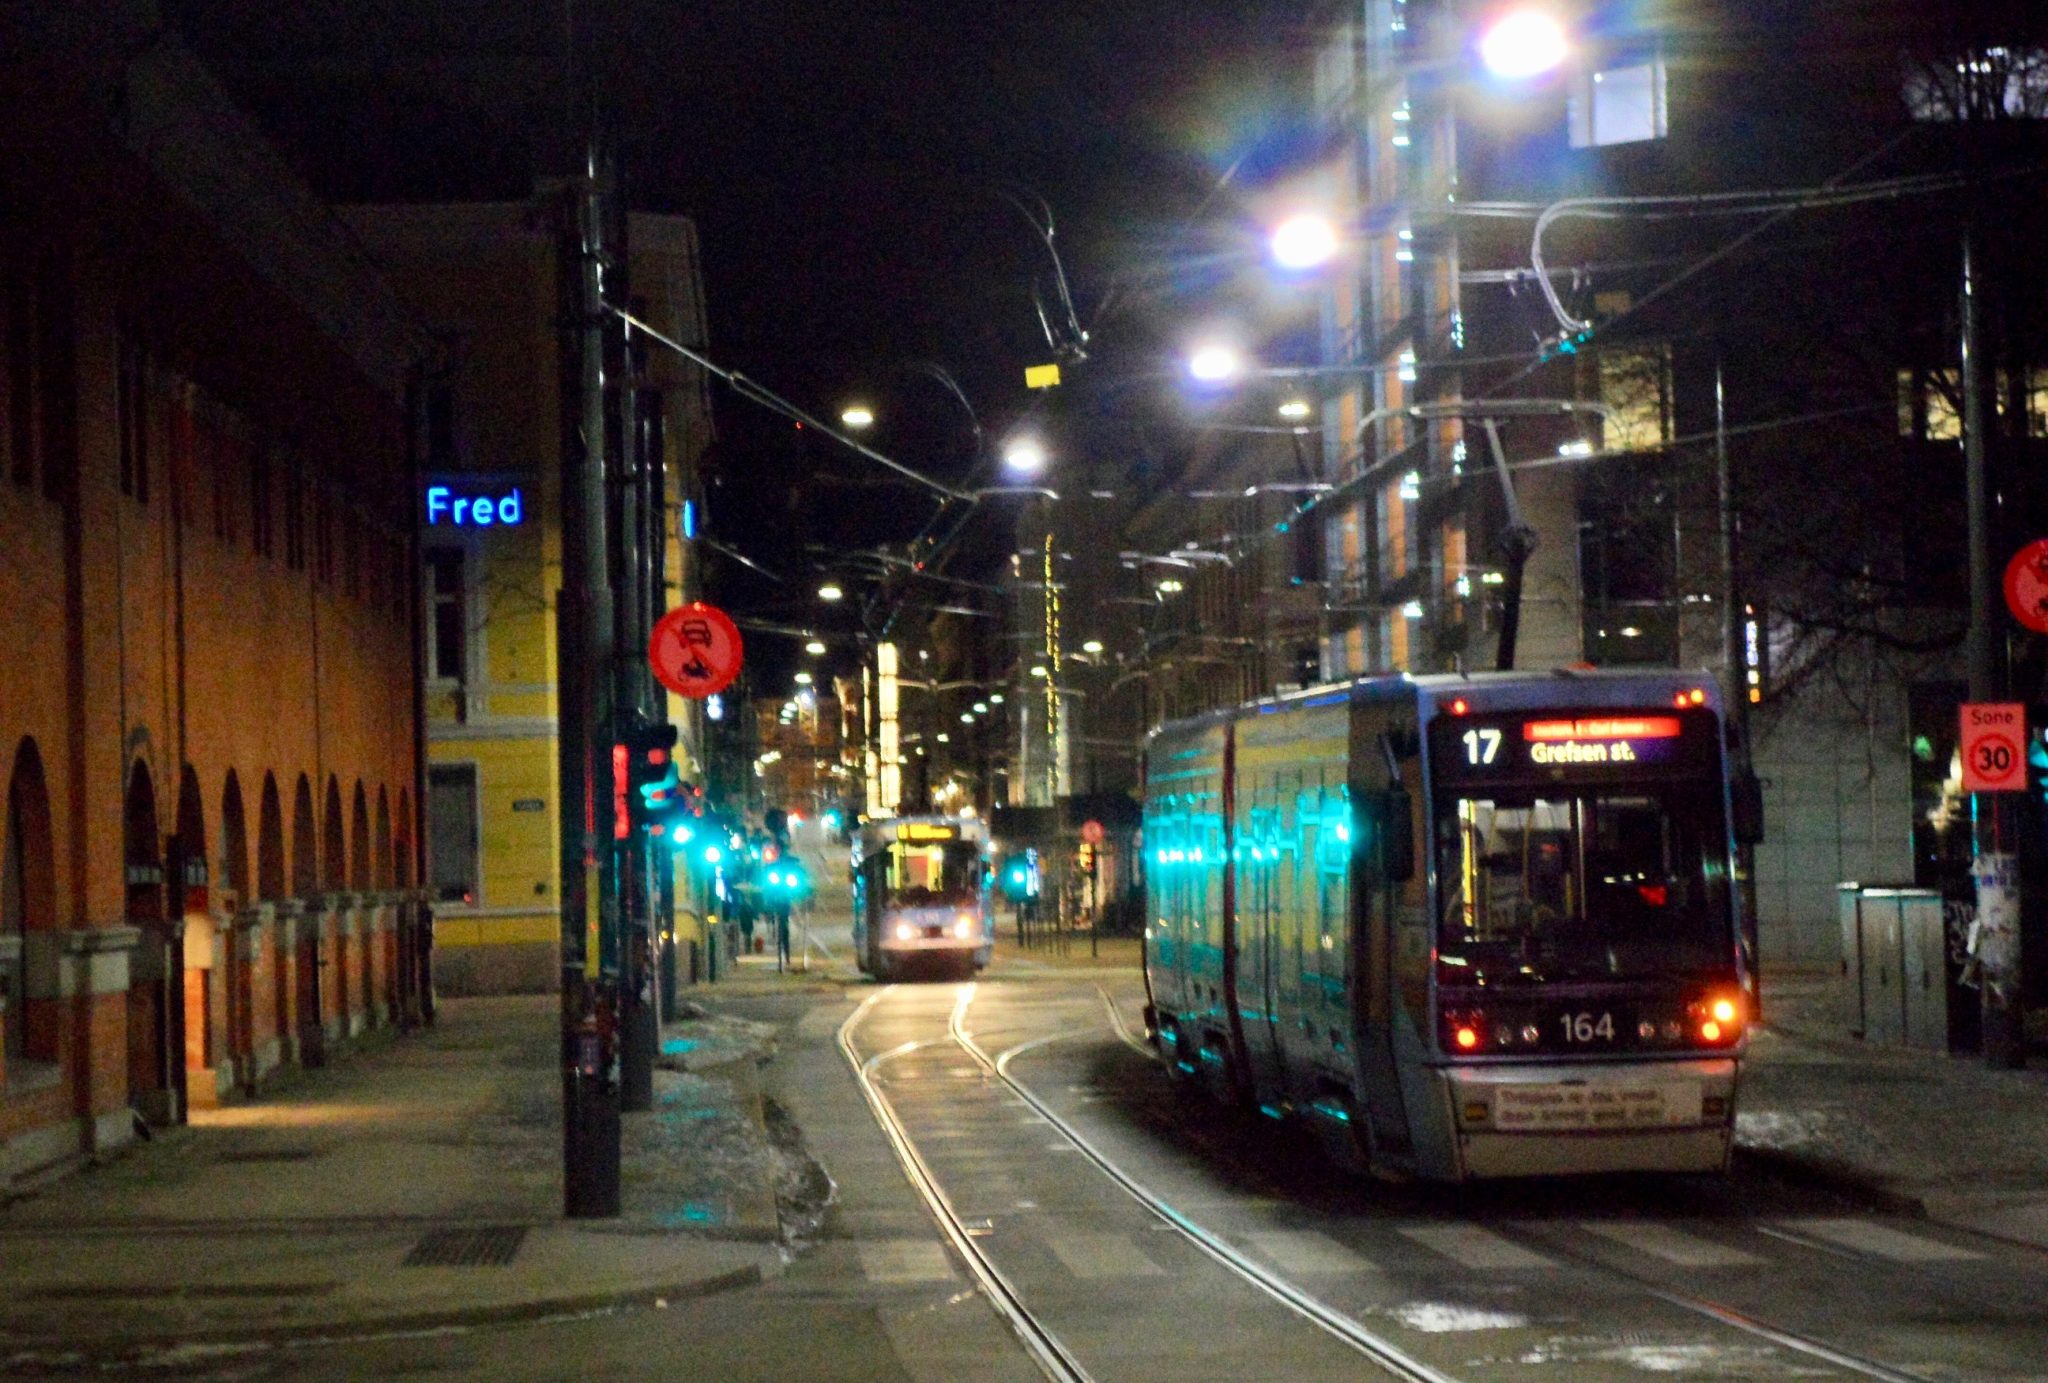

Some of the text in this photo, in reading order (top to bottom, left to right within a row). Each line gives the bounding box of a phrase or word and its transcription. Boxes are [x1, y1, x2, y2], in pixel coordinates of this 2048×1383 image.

[427, 486, 521, 525] Fred
[1971, 709, 2014, 726] Sone
[1462, 729, 1502, 765] 17
[1531, 740, 1635, 764] Grefsen st.
[1979, 747, 2010, 771] 30
[1560, 1012, 1615, 1042] 164
